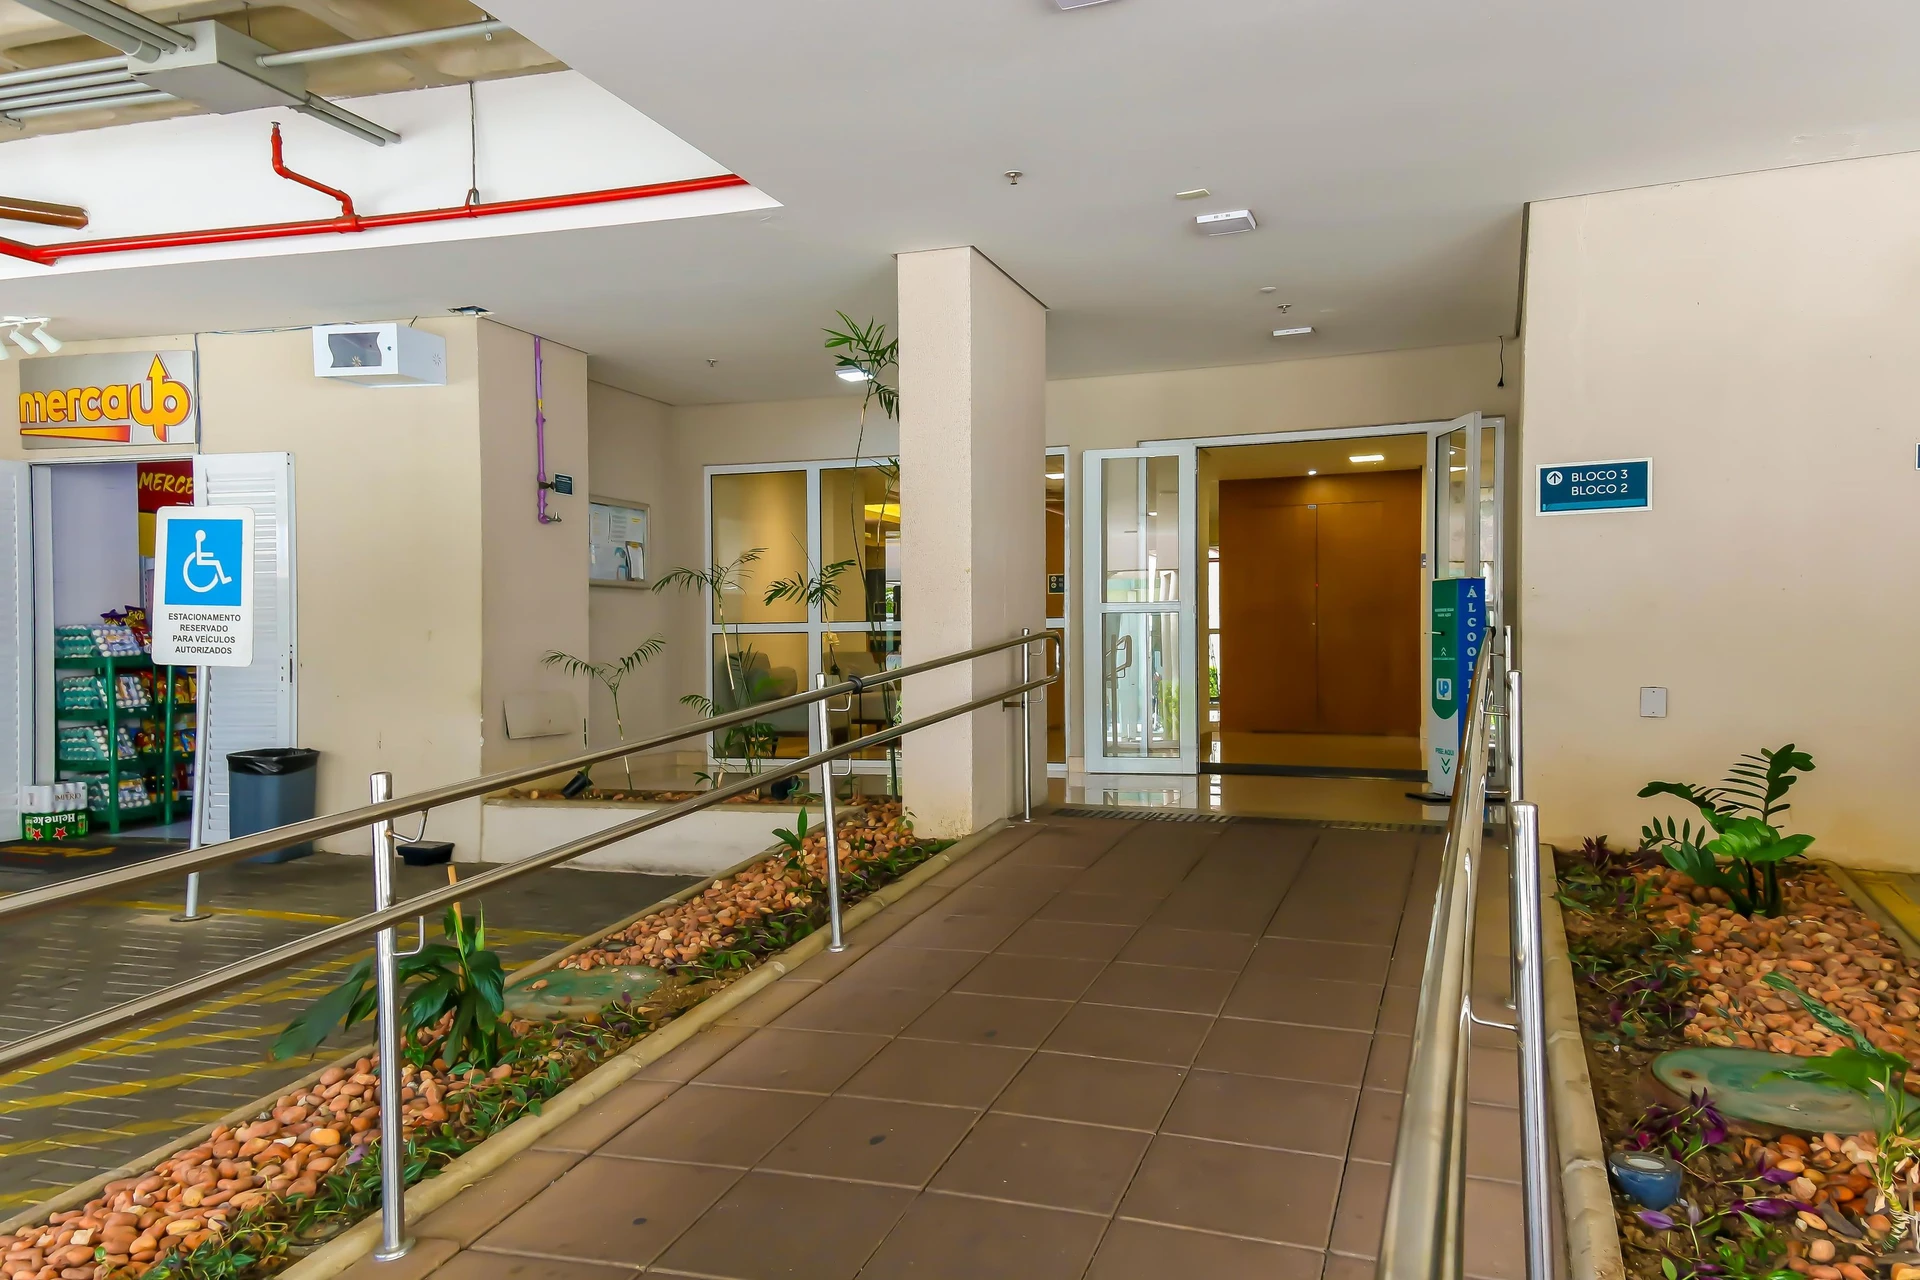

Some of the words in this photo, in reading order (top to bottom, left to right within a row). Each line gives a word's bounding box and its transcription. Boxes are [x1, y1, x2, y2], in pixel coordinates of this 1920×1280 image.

[1571, 470, 1617, 482] BLOCO
[1620, 469, 1628, 479] 3
[1571, 484, 1617, 496] BLOCO
[1620, 483, 1628, 493] 2
[168, 612, 241, 622] ESTACIONAMENTO
[179, 624, 229, 633] RESERVADO
[172, 634, 194, 643] PARA
[195, 634, 236, 644] VEÍCULOS
[174, 646, 232, 655] AUTORIZADOS
